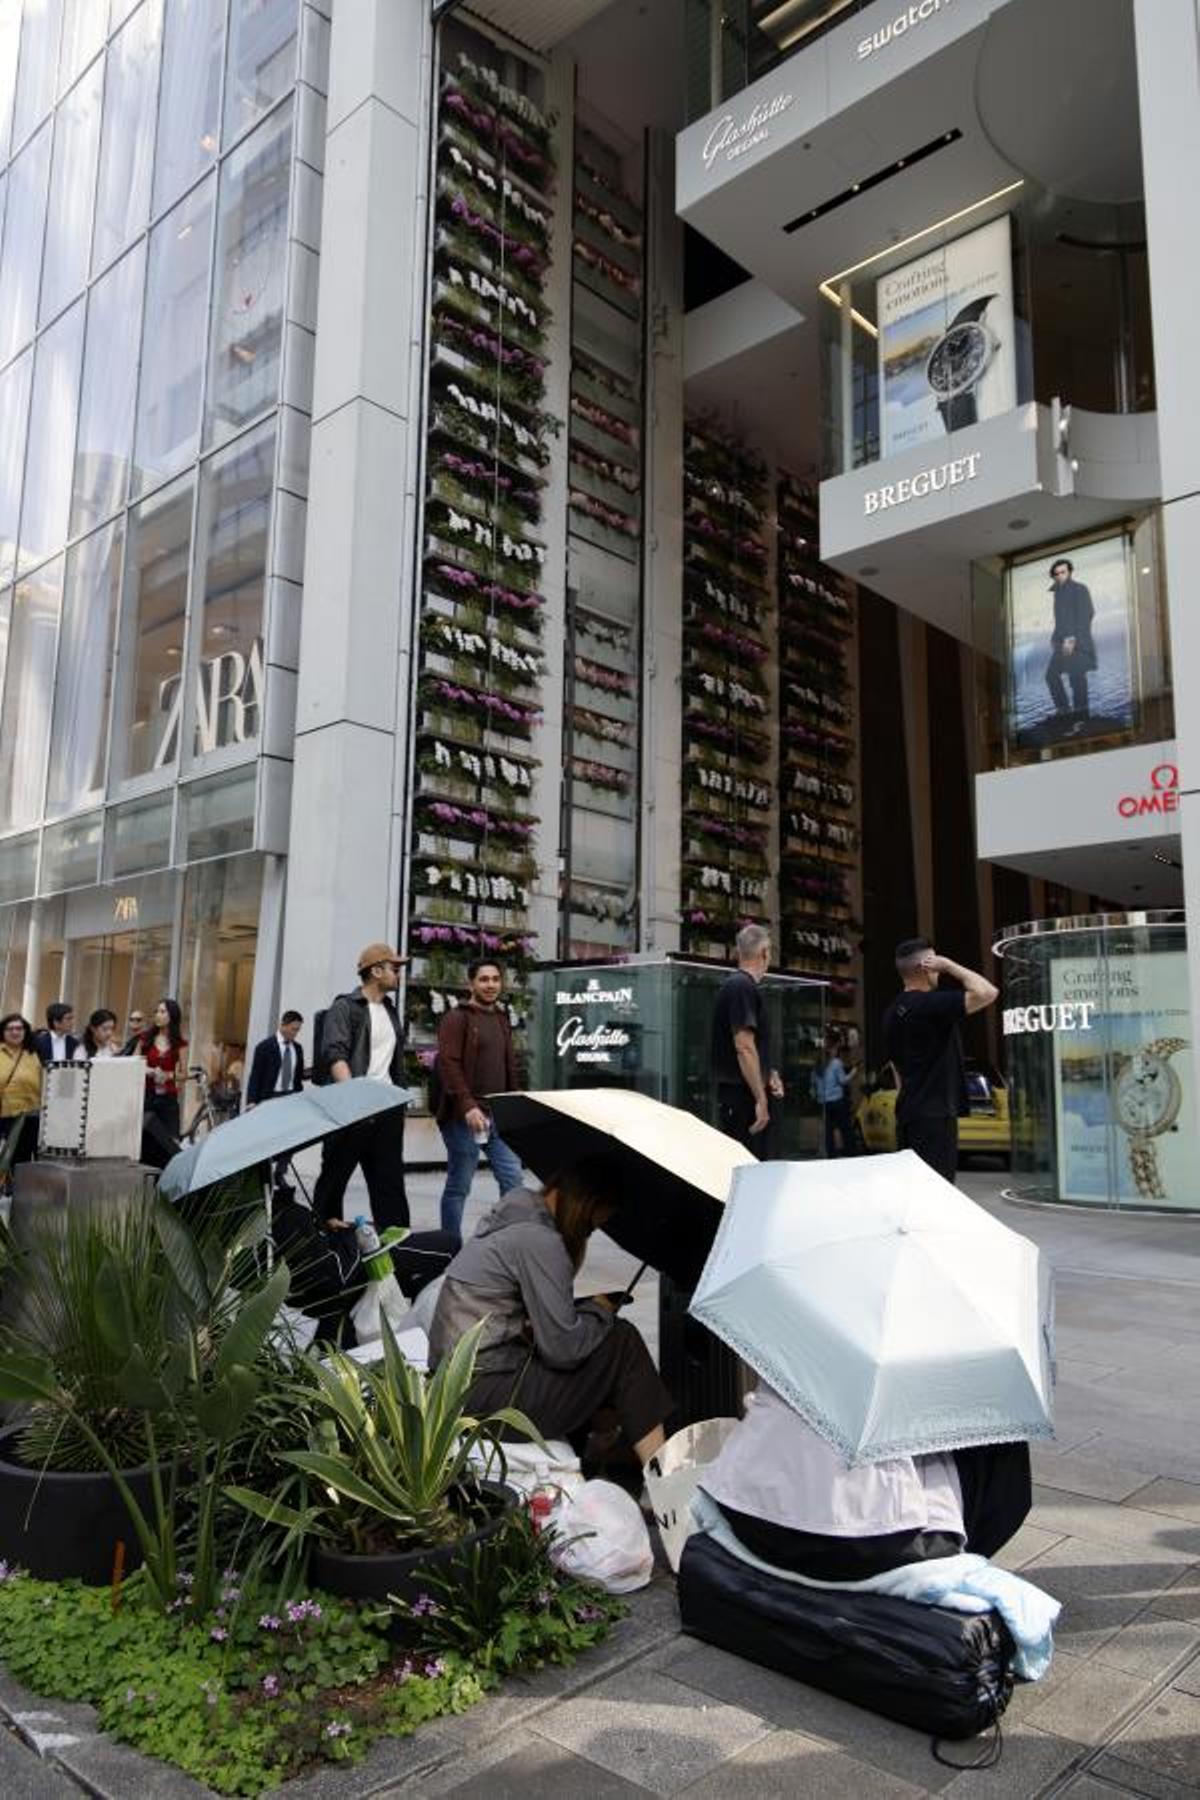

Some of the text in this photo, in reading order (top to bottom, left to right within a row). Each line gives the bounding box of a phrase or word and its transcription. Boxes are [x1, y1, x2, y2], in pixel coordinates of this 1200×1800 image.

[863, 452, 981, 515] BREGUET
[153, 640, 264, 770] ZARA
[1118, 790, 1180, 818] OME
[556, 988, 633, 1004] BLANCPAIN
[1063, 988, 1140, 1001] emoons
[557, 1016, 631, 1057] Glashütte
